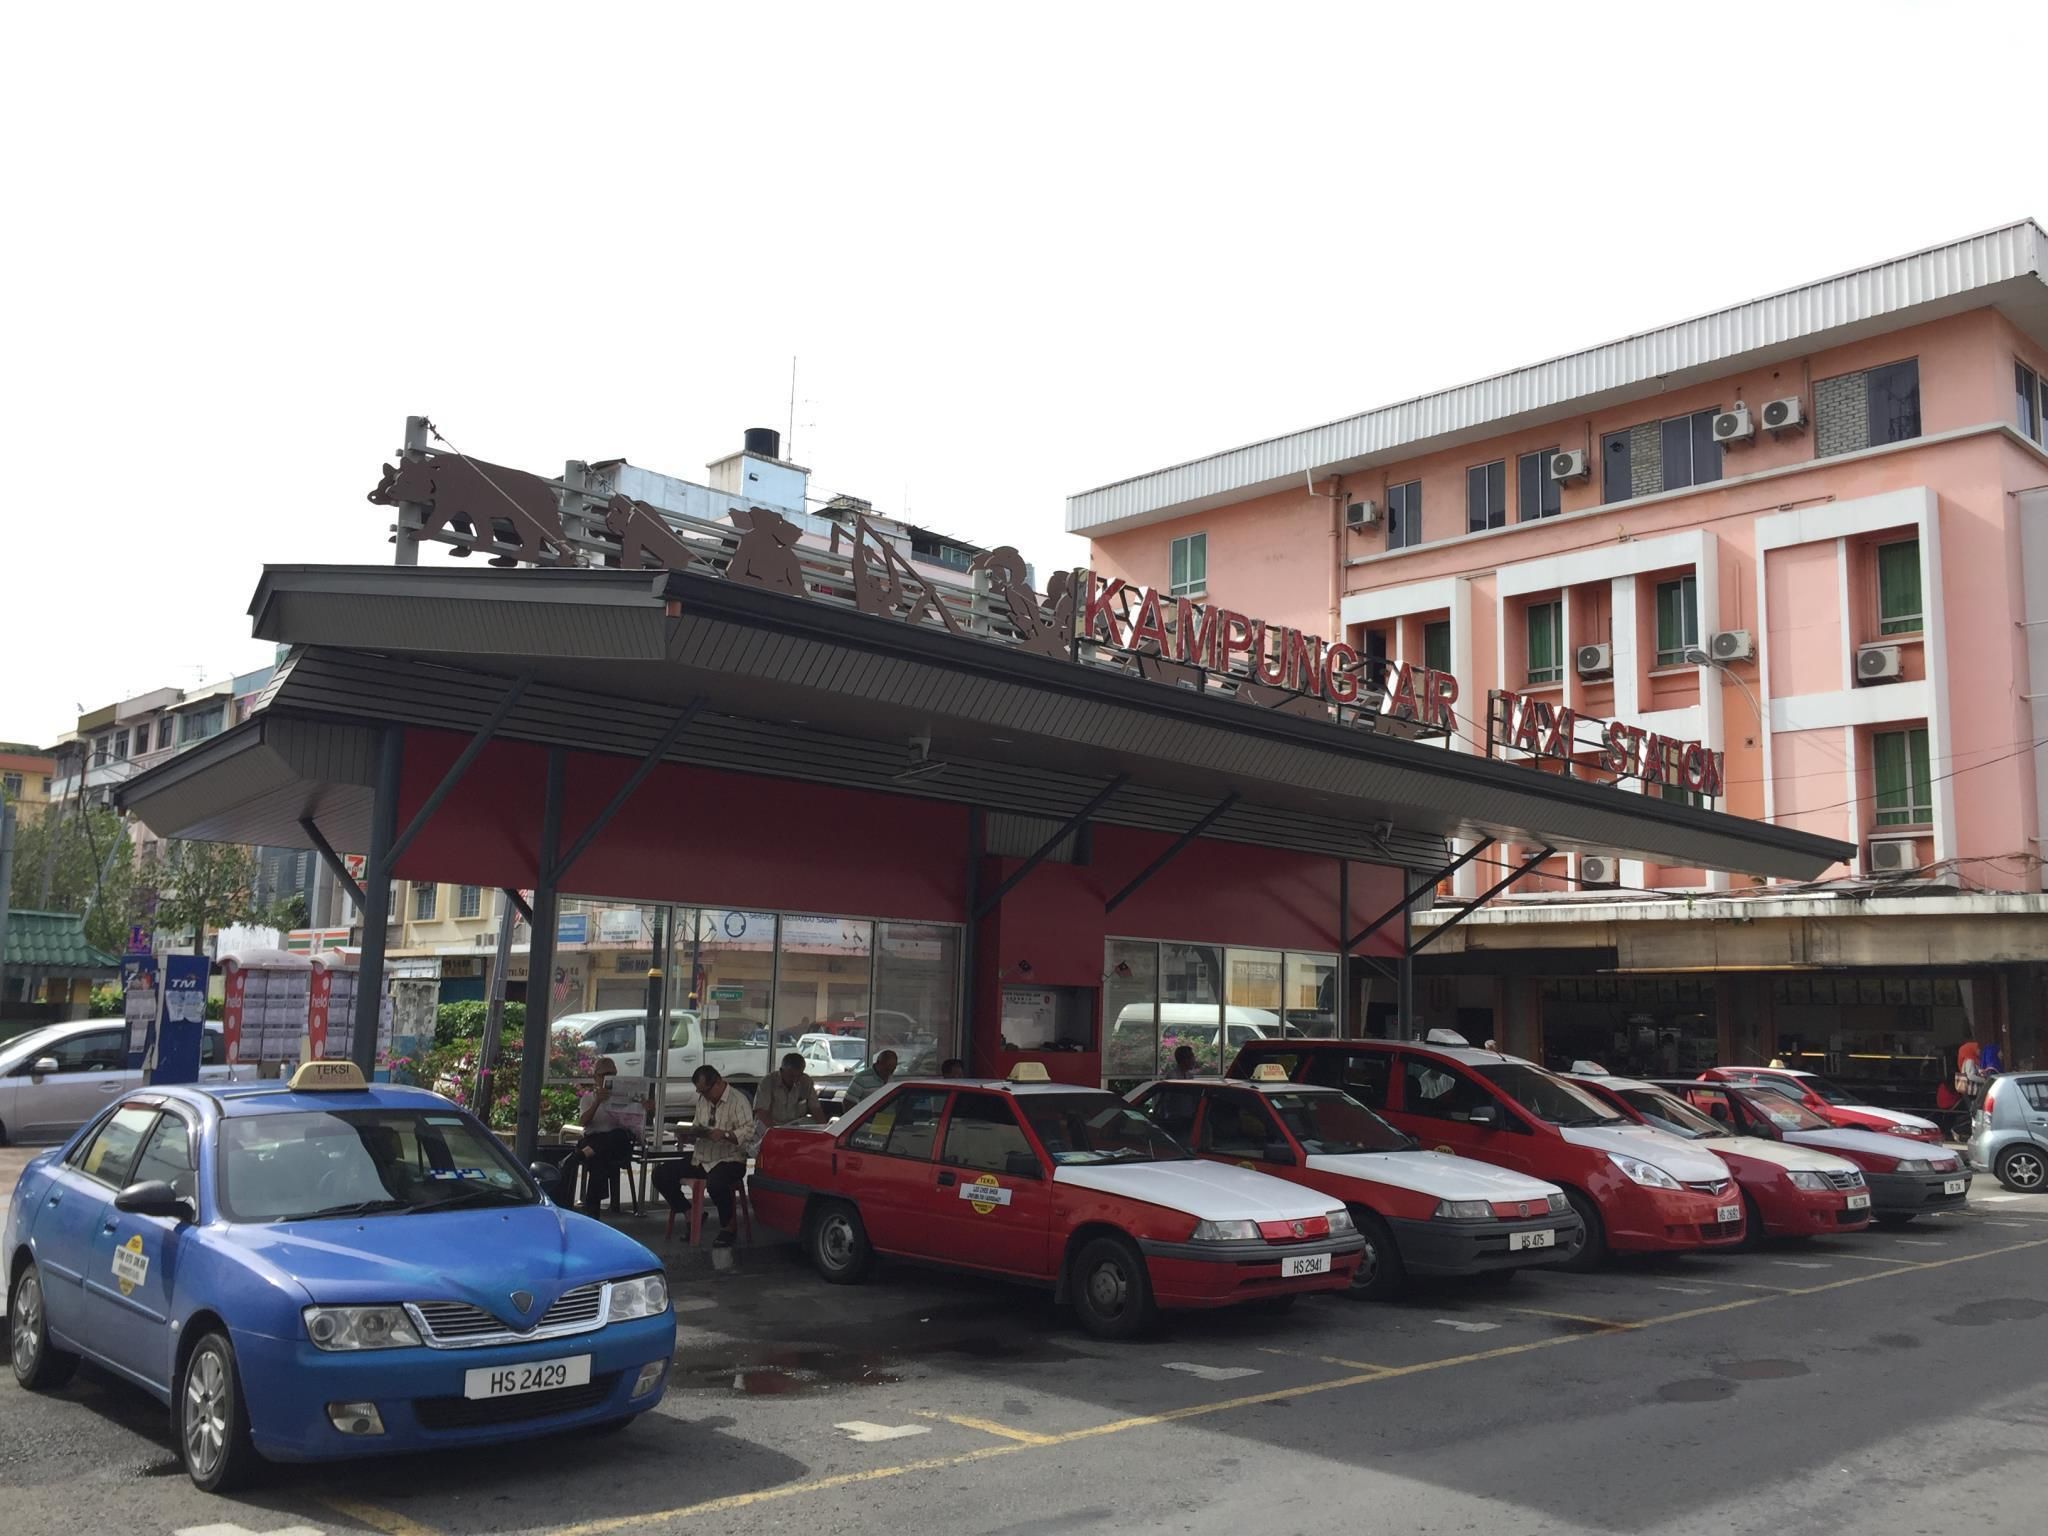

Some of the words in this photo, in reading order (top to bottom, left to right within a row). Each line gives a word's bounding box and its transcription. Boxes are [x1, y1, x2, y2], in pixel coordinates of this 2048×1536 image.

[1084, 570, 1360, 706] KAMPUNG
[1385, 660, 1459, 733] AIR
[1499, 690, 1576, 760] TAXI
[1605, 720, 1726, 798] STATION
[171, 978, 197, 988] TM
[316, 1064, 350, 1075] TEKSI
[1521, 1235, 1531, 1248] HS
[1532, 1233, 1545, 1247] 475
[1293, 1260, 1304, 1275] HS
[1305, 1258, 1322, 1273] 2941
[490, 1370, 516, 1395] HS
[519, 1364, 567, 1391] 2429
